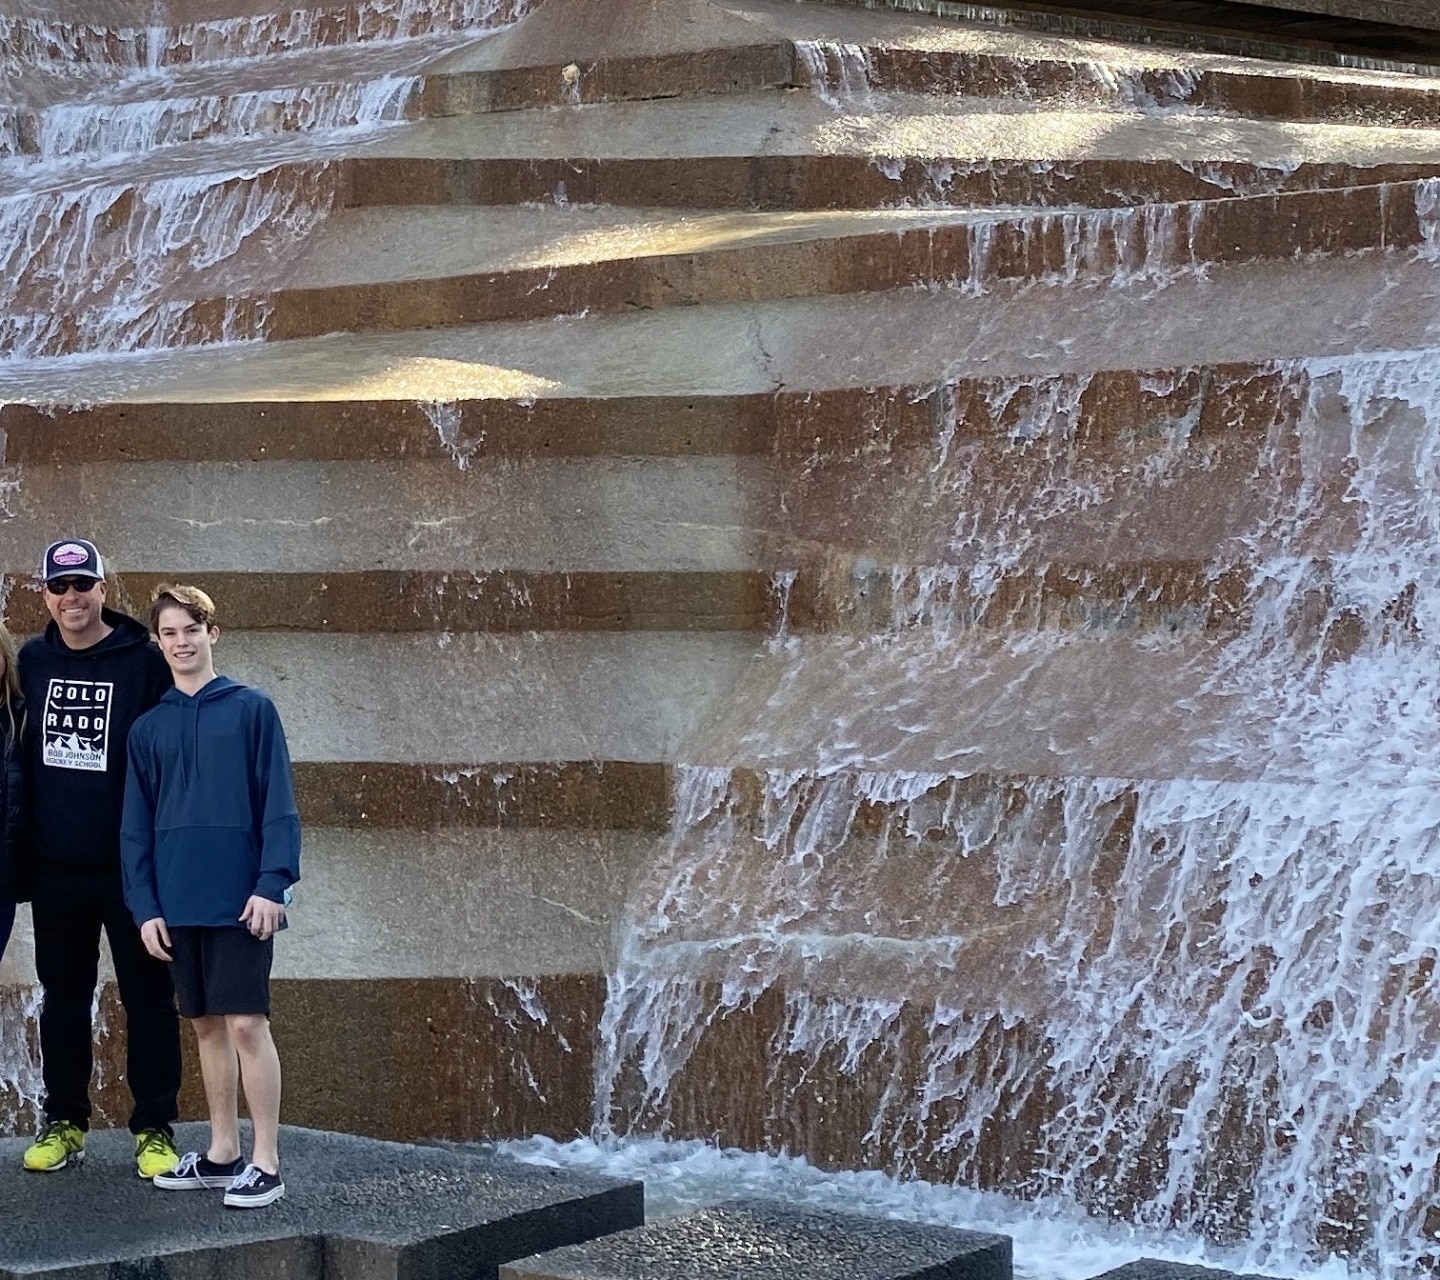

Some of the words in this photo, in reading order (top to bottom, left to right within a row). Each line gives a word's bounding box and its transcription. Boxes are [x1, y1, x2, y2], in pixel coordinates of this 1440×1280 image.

[52, 686, 107, 702] COLO
[47, 713, 105, 730] RADO
[65, 751, 102, 762] JOHNSON
